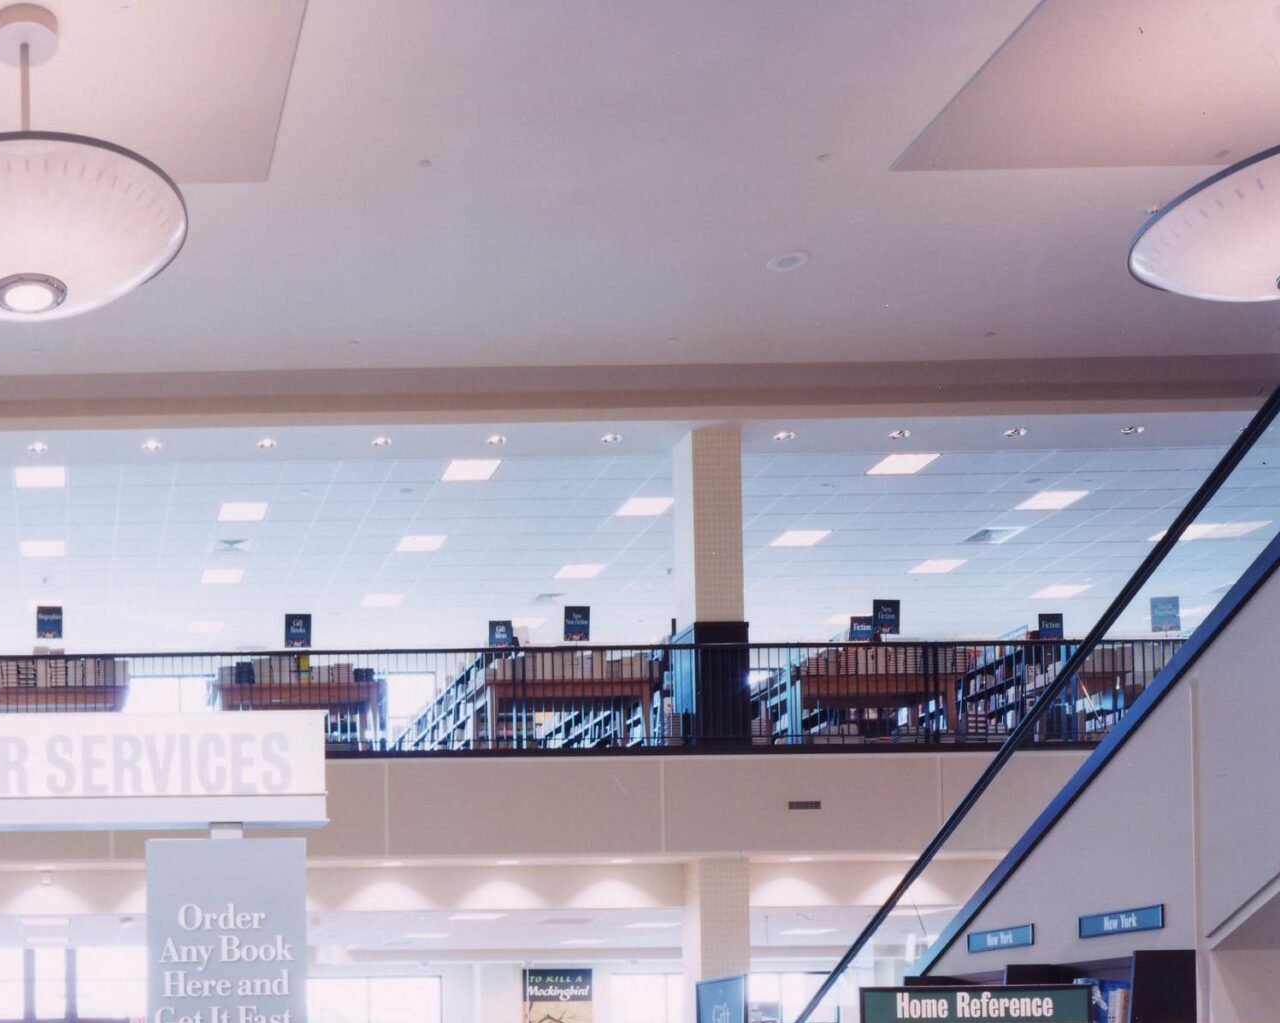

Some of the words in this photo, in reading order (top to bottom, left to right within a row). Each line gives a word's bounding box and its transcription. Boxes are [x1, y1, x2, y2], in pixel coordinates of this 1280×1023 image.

[46, 731, 293, 797] SERVICES
[177, 903, 266, 932] Order
[1104, 916, 1118, 931] New
[1119, 913, 1138, 928] York
[159, 937, 214, 972] Any
[218, 935, 294, 963] Book
[163, 971, 231, 998] Here
[236, 970, 290, 998] and
[545, 975, 572, 983] KILL
[576, 975, 583, 983] A
[527, 985, 590, 1001] Mockingbird
[896, 992, 949, 1018] Home
[956, 991, 1054, 1018] Reference
